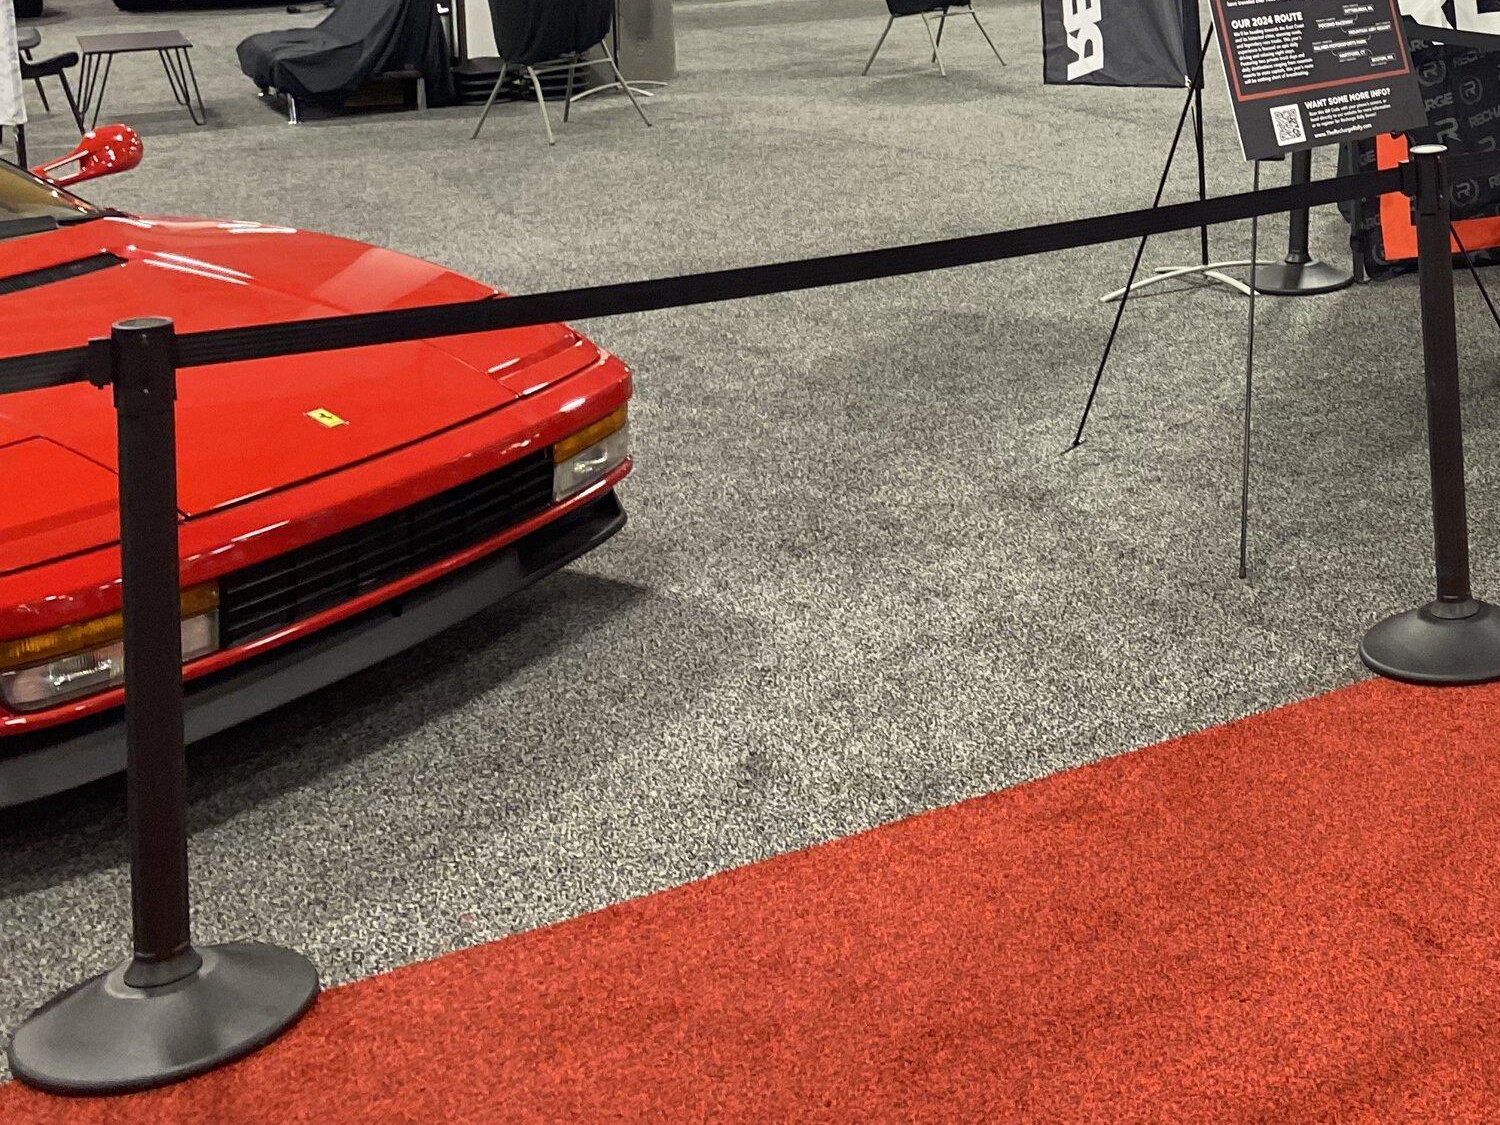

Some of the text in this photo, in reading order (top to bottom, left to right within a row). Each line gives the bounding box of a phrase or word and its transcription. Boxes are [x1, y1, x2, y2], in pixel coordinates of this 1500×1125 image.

[1230, 18, 1251, 29] OUR
[1250, 15, 1273, 26] 2024
[1273, 11, 1303, 23] ROUTE
[1304, 98, 1327, 109] WANT
[1327, 94, 1348, 105] SOME
[1348, 90, 1369, 101] MORE
[1369, 87, 1391, 97] INFO?
